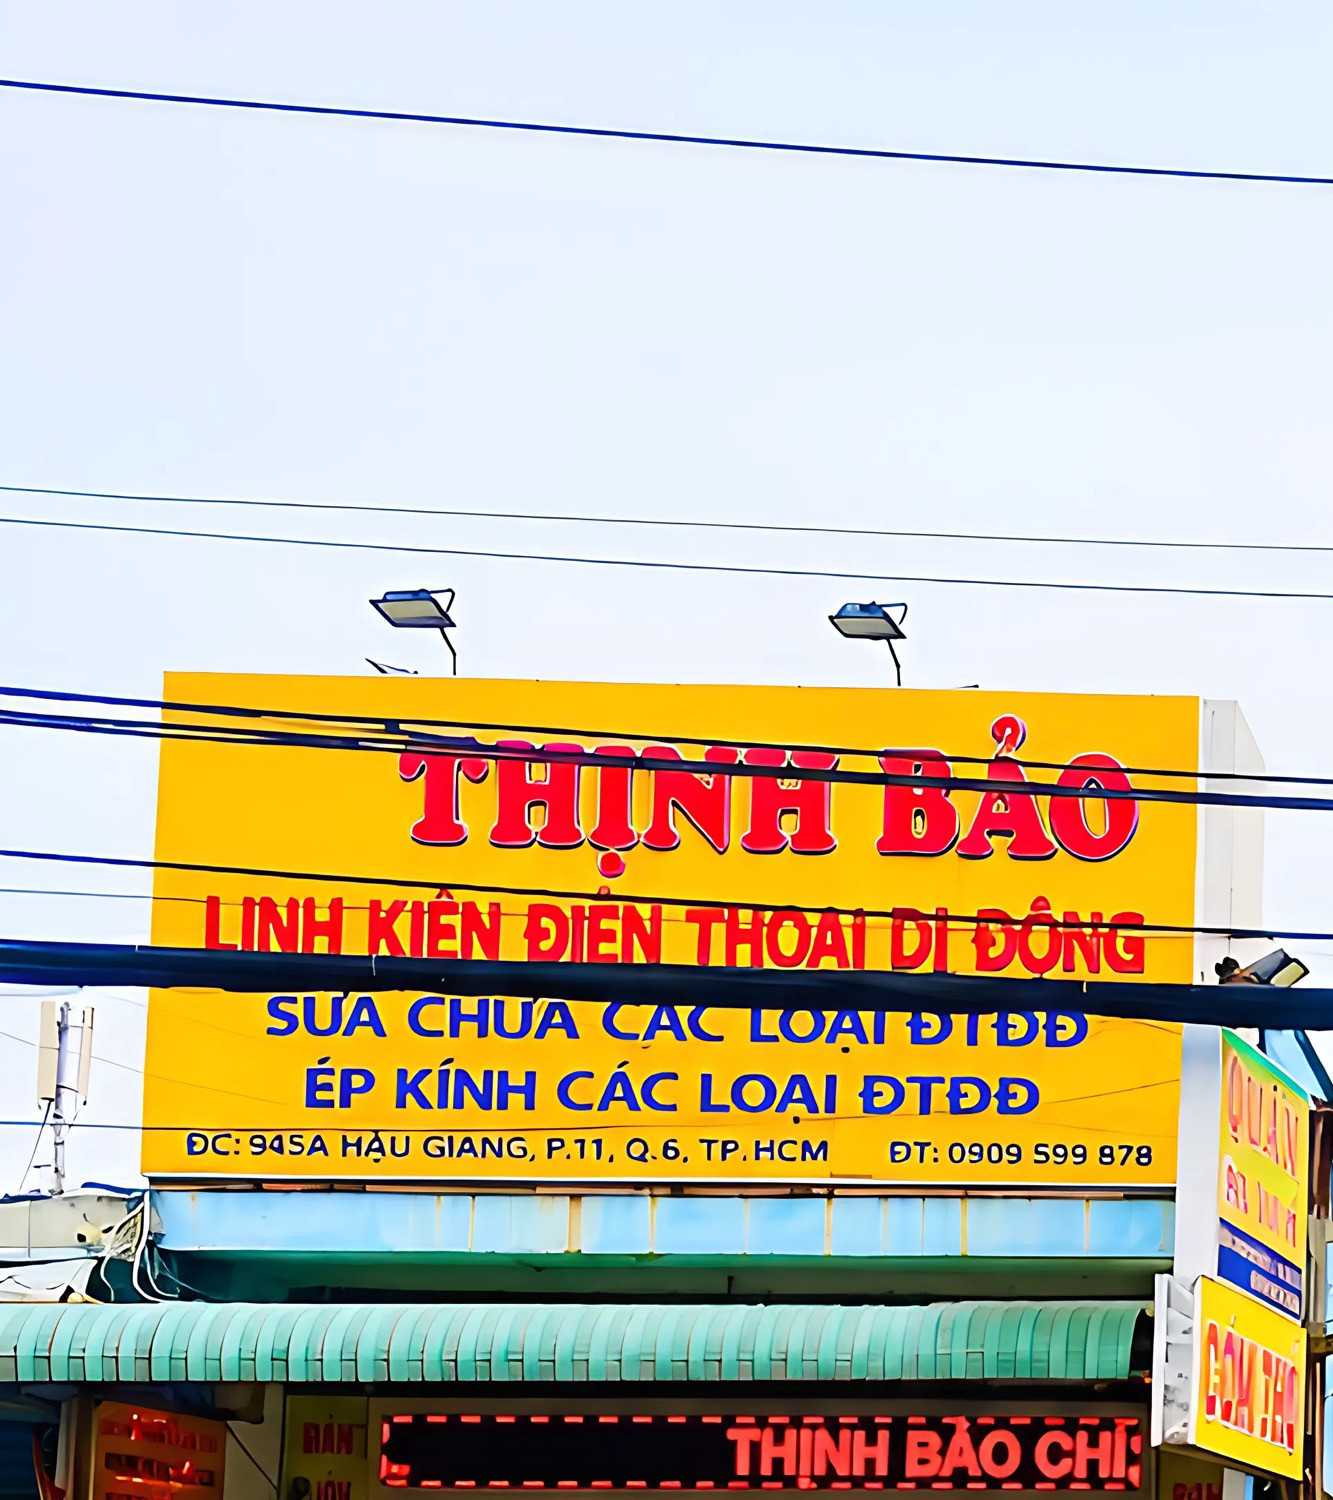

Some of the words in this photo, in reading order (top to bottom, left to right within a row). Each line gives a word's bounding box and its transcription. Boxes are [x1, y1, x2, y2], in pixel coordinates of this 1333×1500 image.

[398, 741, 838, 878] THỊNH
[876, 713, 1138, 862] BẢO
[205, 895, 343, 955] LINH
[305, 1056, 376, 1109] ÉP
[395, 1058, 536, 1110] KÍNH
[557, 1061, 678, 1112] CÁC
[701, 1073, 837, 1124] LOẠI
[949, 1140, 1022, 1166] 0909
[1033, 1142, 1087, 1166] 599
[1098, 1143, 1154, 1167] 878
[727, 1427, 889, 1489] THỊNH
[905, 1415, 1021, 1478] BẢO
